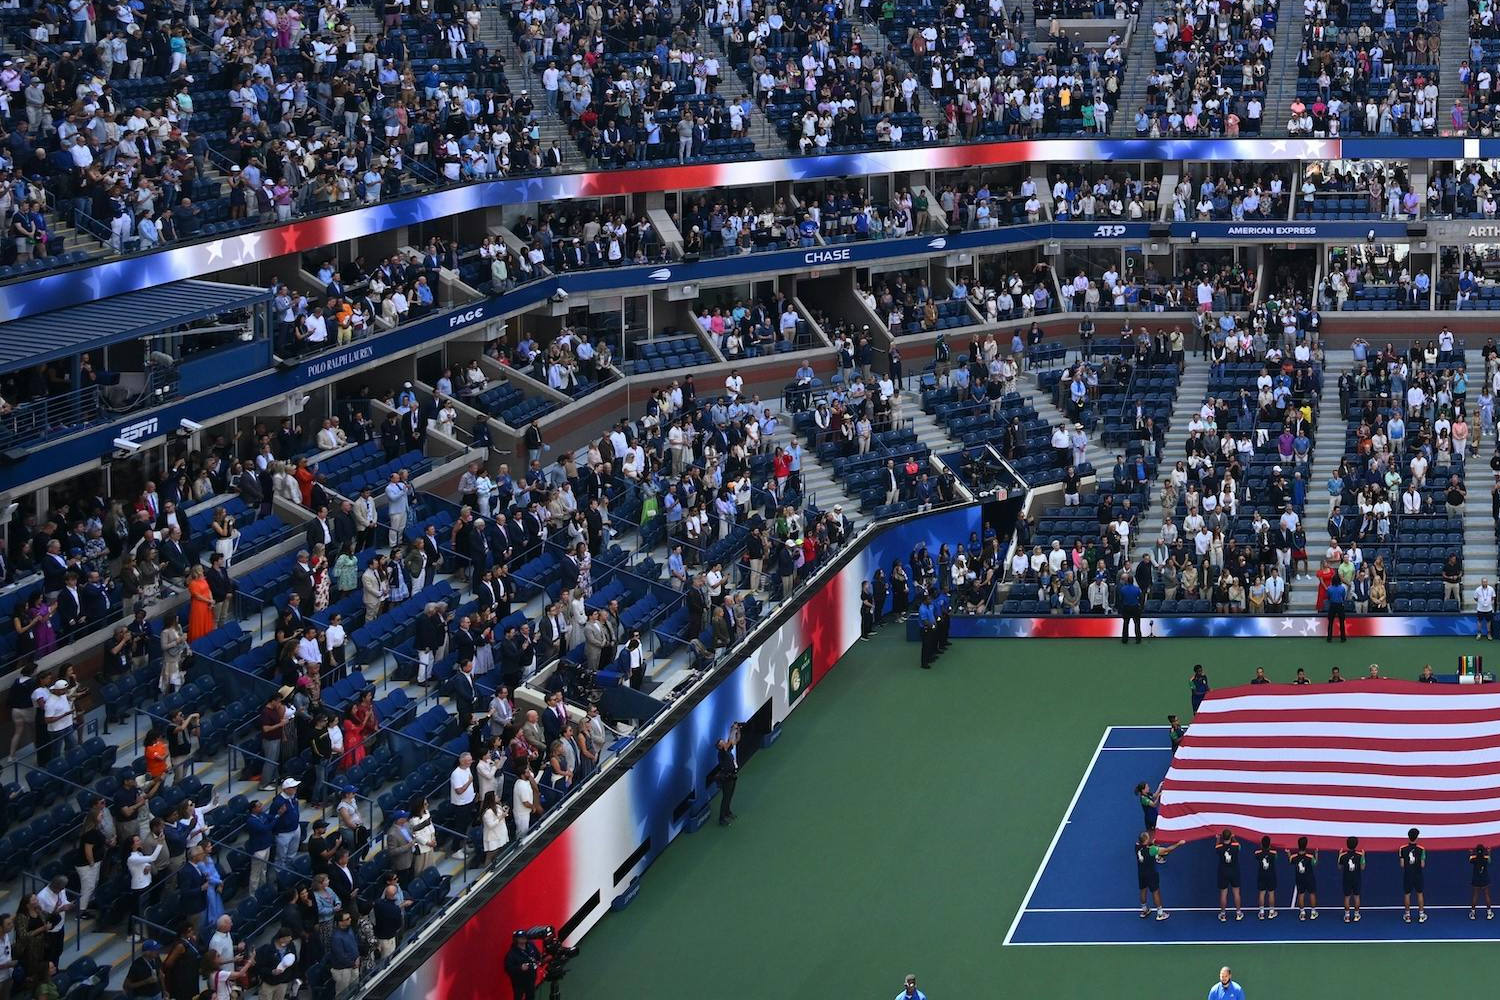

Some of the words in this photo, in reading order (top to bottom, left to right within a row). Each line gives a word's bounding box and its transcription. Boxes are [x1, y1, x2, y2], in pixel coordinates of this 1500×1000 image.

[1094, 225, 1126, 237] ATP
[1228, 227, 1274, 235] AMERICAN
[1276, 227, 1317, 235] EXPRESS
[805, 249, 850, 263] CHASE
[450, 308, 483, 328] FAGE
[307, 362, 326, 377] POLO
[326, 354, 348, 371] RALPH
[348, 346, 373, 363] LAUREN
[121, 417, 158, 440] ESPN
